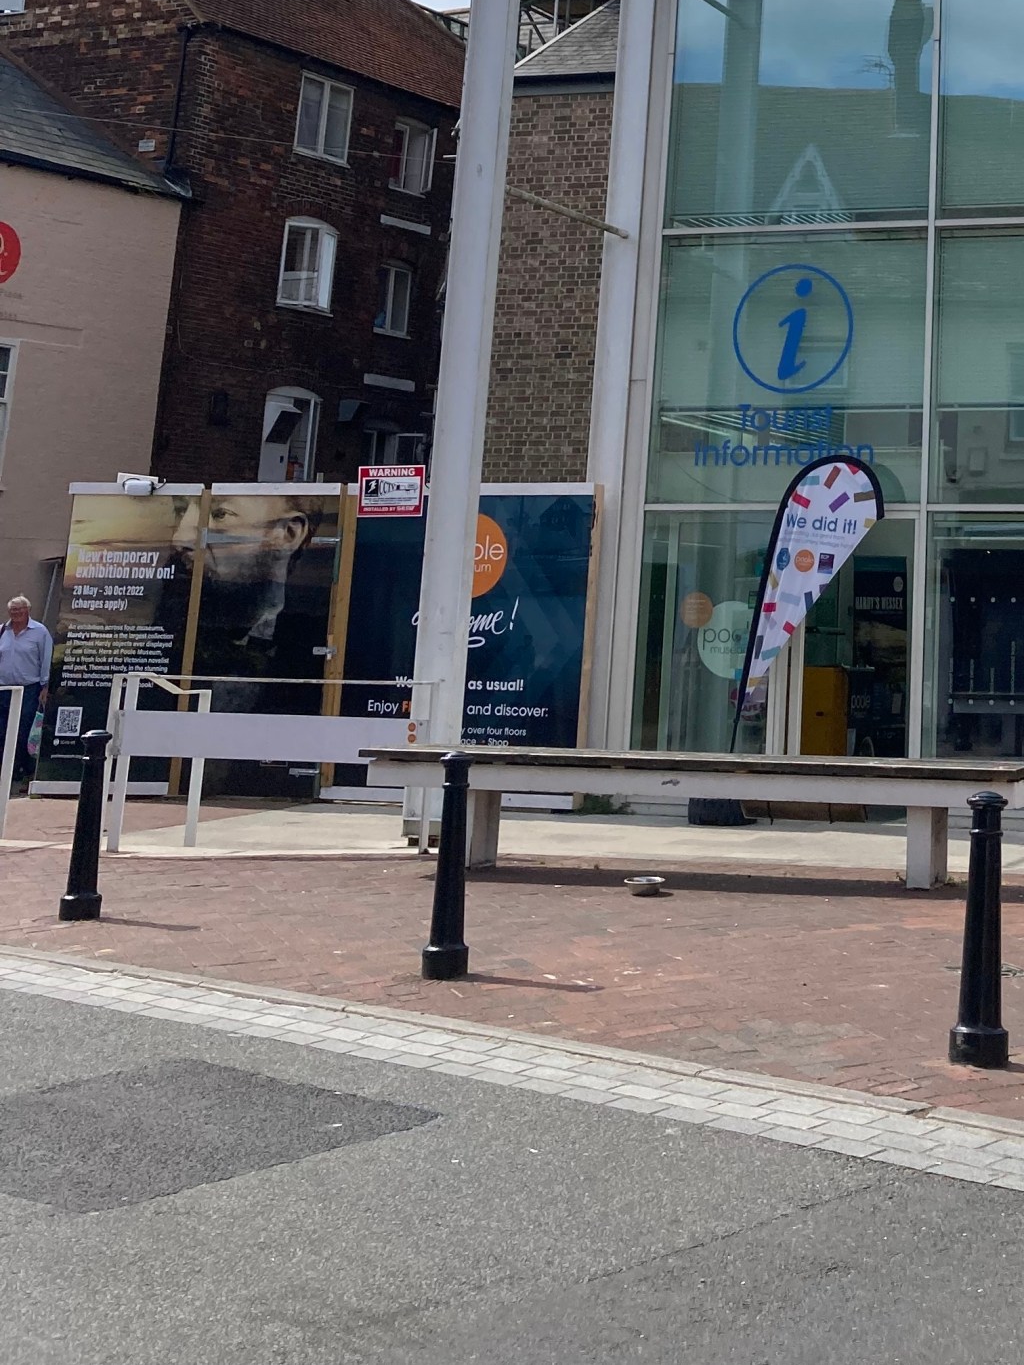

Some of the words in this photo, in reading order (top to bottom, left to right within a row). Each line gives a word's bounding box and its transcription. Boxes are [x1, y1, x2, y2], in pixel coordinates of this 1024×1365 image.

[737, 403, 833, 432] Tourist
[368, 468, 416, 477] WARNING
[786, 513, 807, 528] We
[812, 516, 838, 532] did
[843, 519, 857, 534] it!
[474, 535, 504, 560] ole
[77, 548, 100, 563] New
[102, 549, 159, 566] temporary
[76, 564, 130, 579] exhibition
[131, 566, 155, 579] now
[156, 565, 175, 579] on!
[83, 585, 98, 597] May
[103, 585, 113, 595] 30
[114, 585, 126, 595] Oct
[127, 586, 144, 595] 2022
[72, 598, 103, 611] (charges
[105, 598, 128, 611] apply)
[467, 680, 483, 691] as
[486, 678, 524, 691] usual!
[367, 699, 400, 715] Enjoy
[467, 703, 491, 717] and
[494, 704, 549, 718] discover:
[467, 727, 485, 735] over
[486, 726, 503, 735] four
[504, 727, 527, 736] floors
[461, 738, 476, 746] ace
[488, 737, 509, 747] Shop
